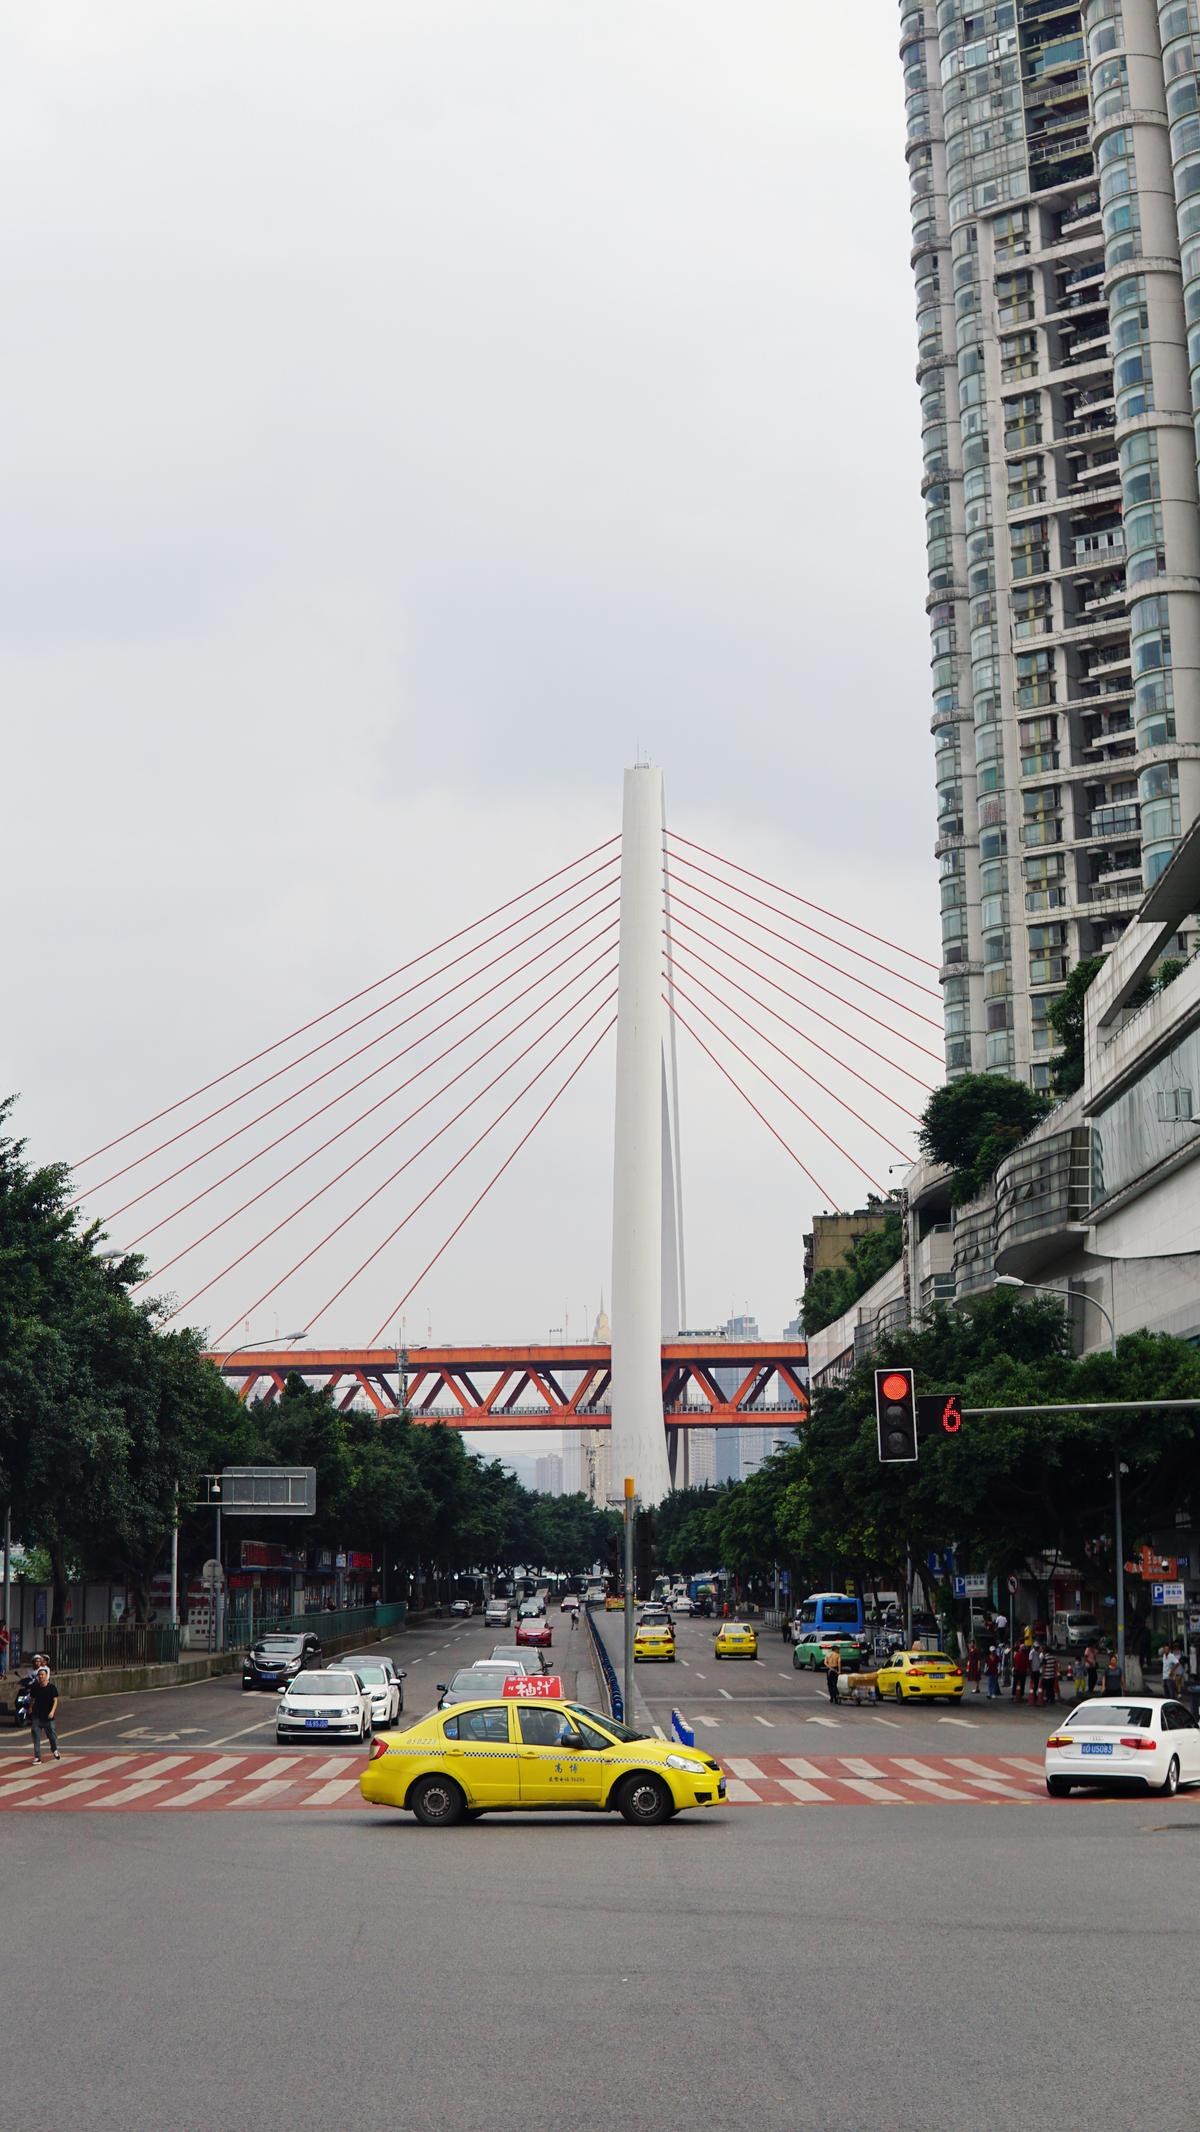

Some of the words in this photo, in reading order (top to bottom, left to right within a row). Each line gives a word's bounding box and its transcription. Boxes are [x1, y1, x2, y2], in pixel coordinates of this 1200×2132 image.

[943, 1397, 960, 1432] 6
[955, 1577, 965, 1593] P
[1154, 1586, 1163, 1598] P
